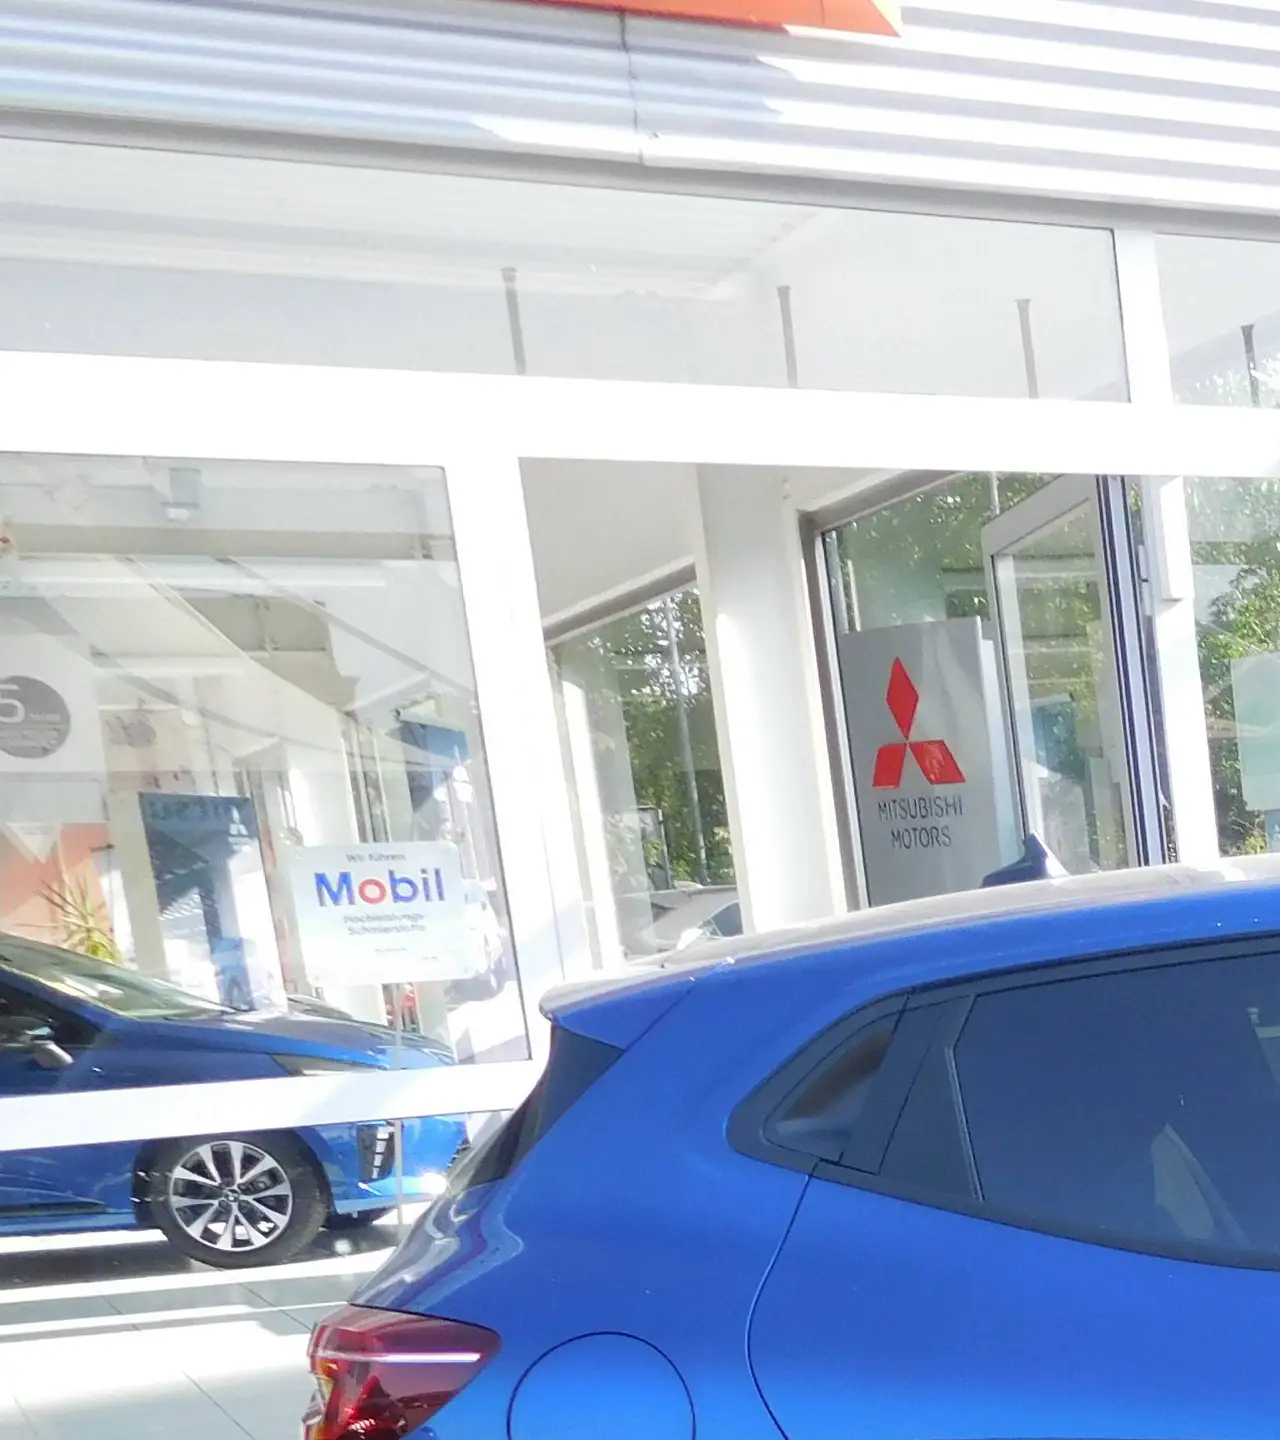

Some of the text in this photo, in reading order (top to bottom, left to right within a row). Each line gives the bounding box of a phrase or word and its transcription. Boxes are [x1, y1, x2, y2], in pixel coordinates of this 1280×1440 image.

[878, 796, 963, 820] MITSUBISHI
[891, 825, 952, 849] MOTORS
[314, 868, 445, 907] Mobil
